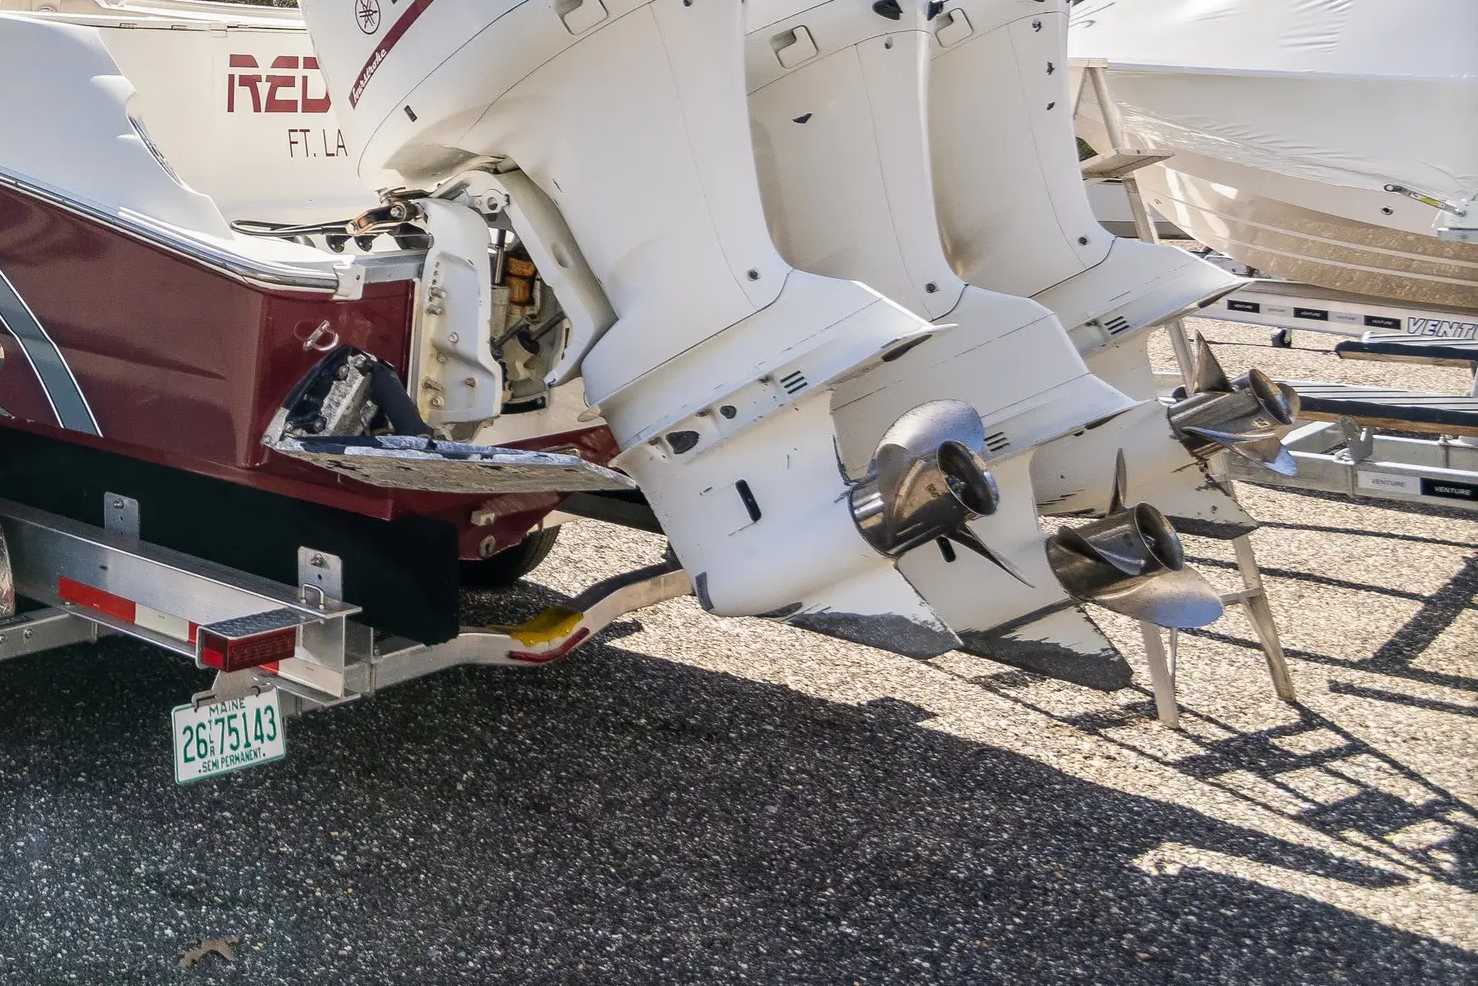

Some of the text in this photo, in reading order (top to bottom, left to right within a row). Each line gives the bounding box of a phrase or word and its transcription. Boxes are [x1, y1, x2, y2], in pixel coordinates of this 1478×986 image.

[226, 53, 332, 113] RED
[287, 128, 317, 158] FT.
[1407, 316, 1478, 341] VENT
[1371, 478, 1407, 488] VENTURE
[1434, 486, 1472, 496] VENTURE
[208, 698, 246, 717] MAINE
[182, 721, 209, 764] 26
[214, 704, 278, 755] 75143
[202, 747, 262, 773] SEMI PERMANENT
